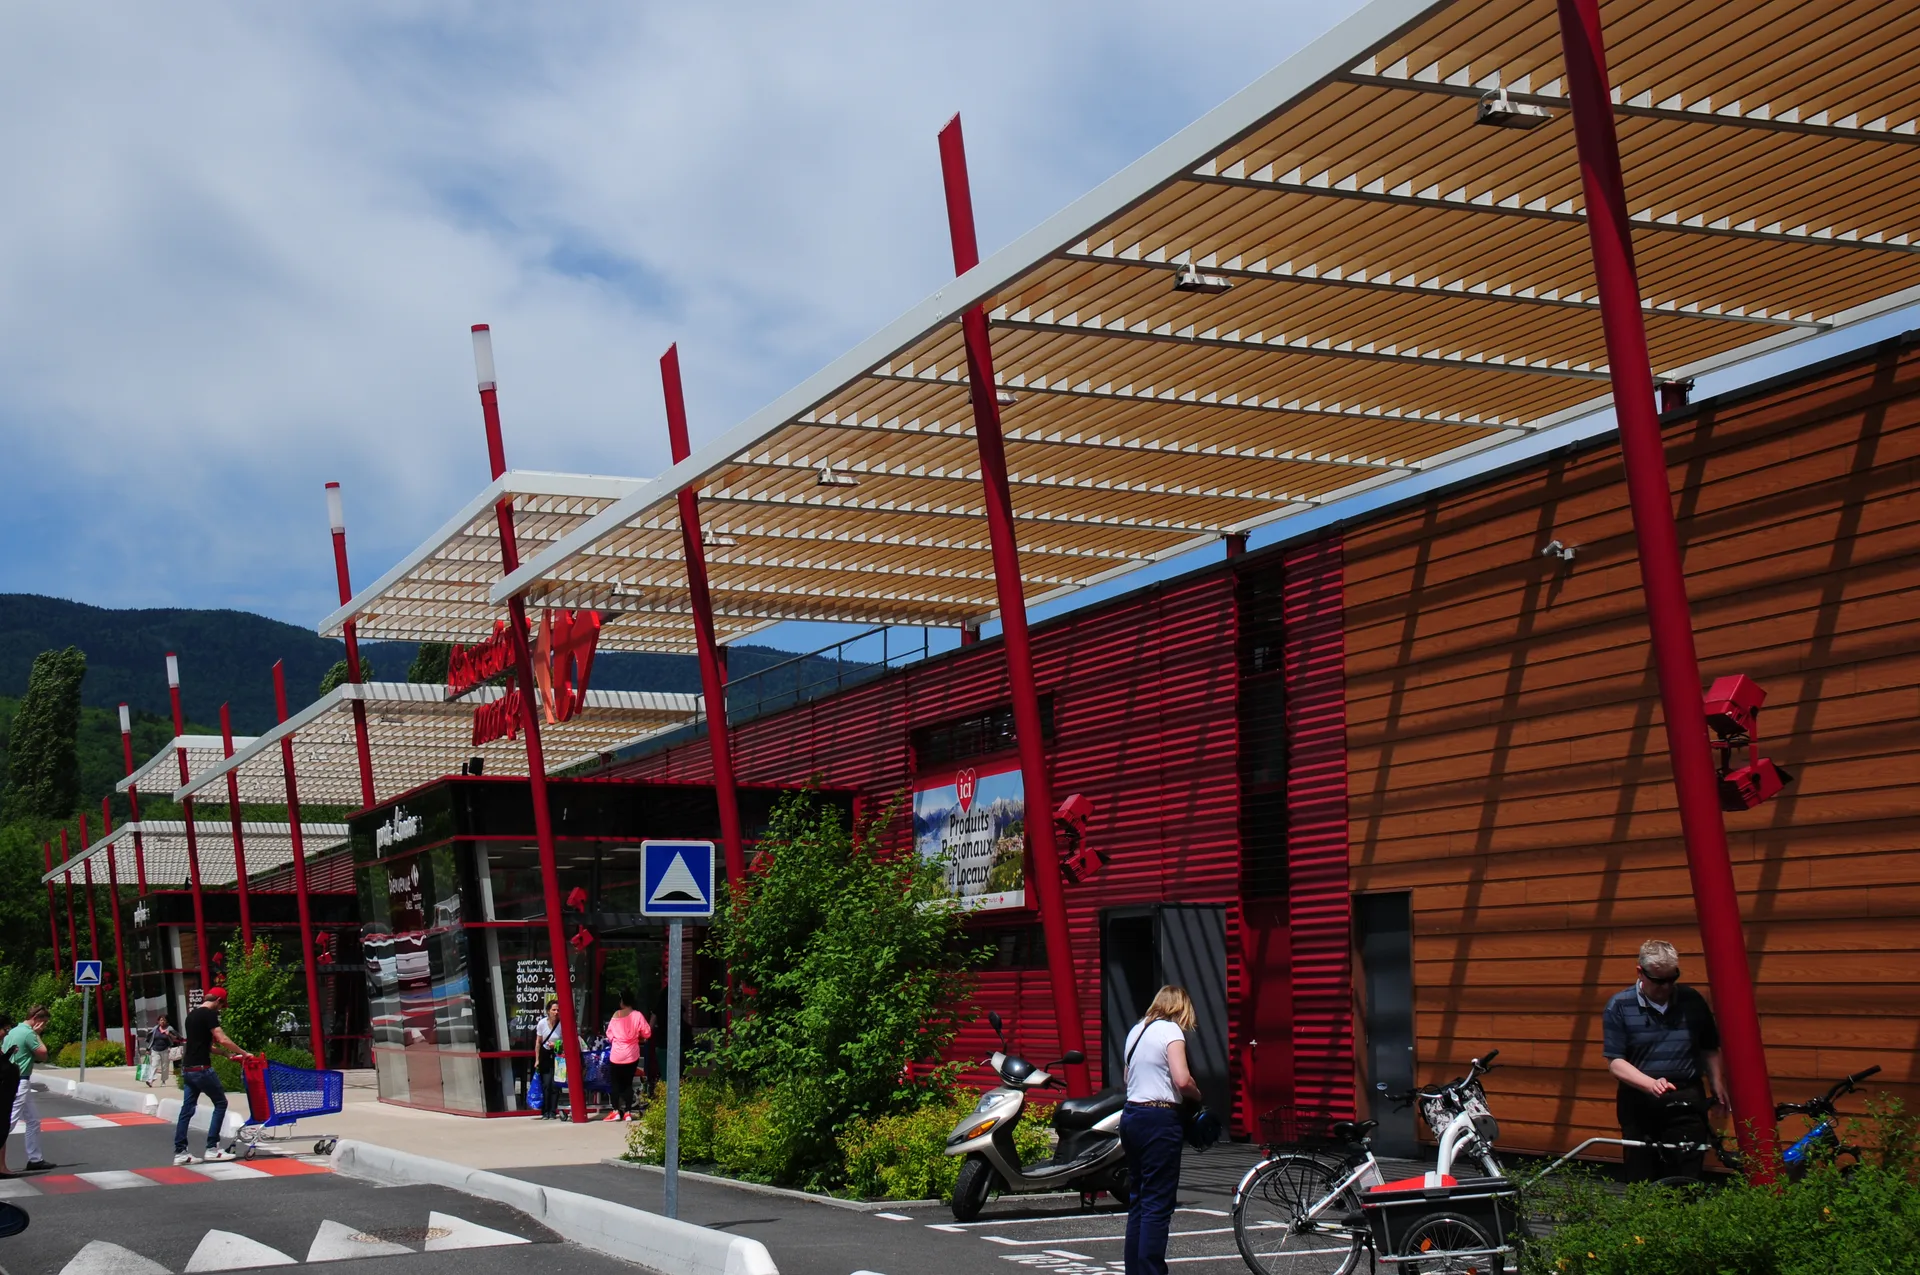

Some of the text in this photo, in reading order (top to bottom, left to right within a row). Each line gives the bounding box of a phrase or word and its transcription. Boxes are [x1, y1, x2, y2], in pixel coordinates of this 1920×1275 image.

[959, 776, 972, 800] ici
[949, 808, 989, 837] Produits
[948, 864, 990, 887] et Locaux
[516, 965, 526, 973] du
[526, 965, 543, 973] lundi
[516, 974, 538, 984] 8h00
[516, 984, 555, 993] le dimanche
[516, 993, 538, 1003] 8h30
